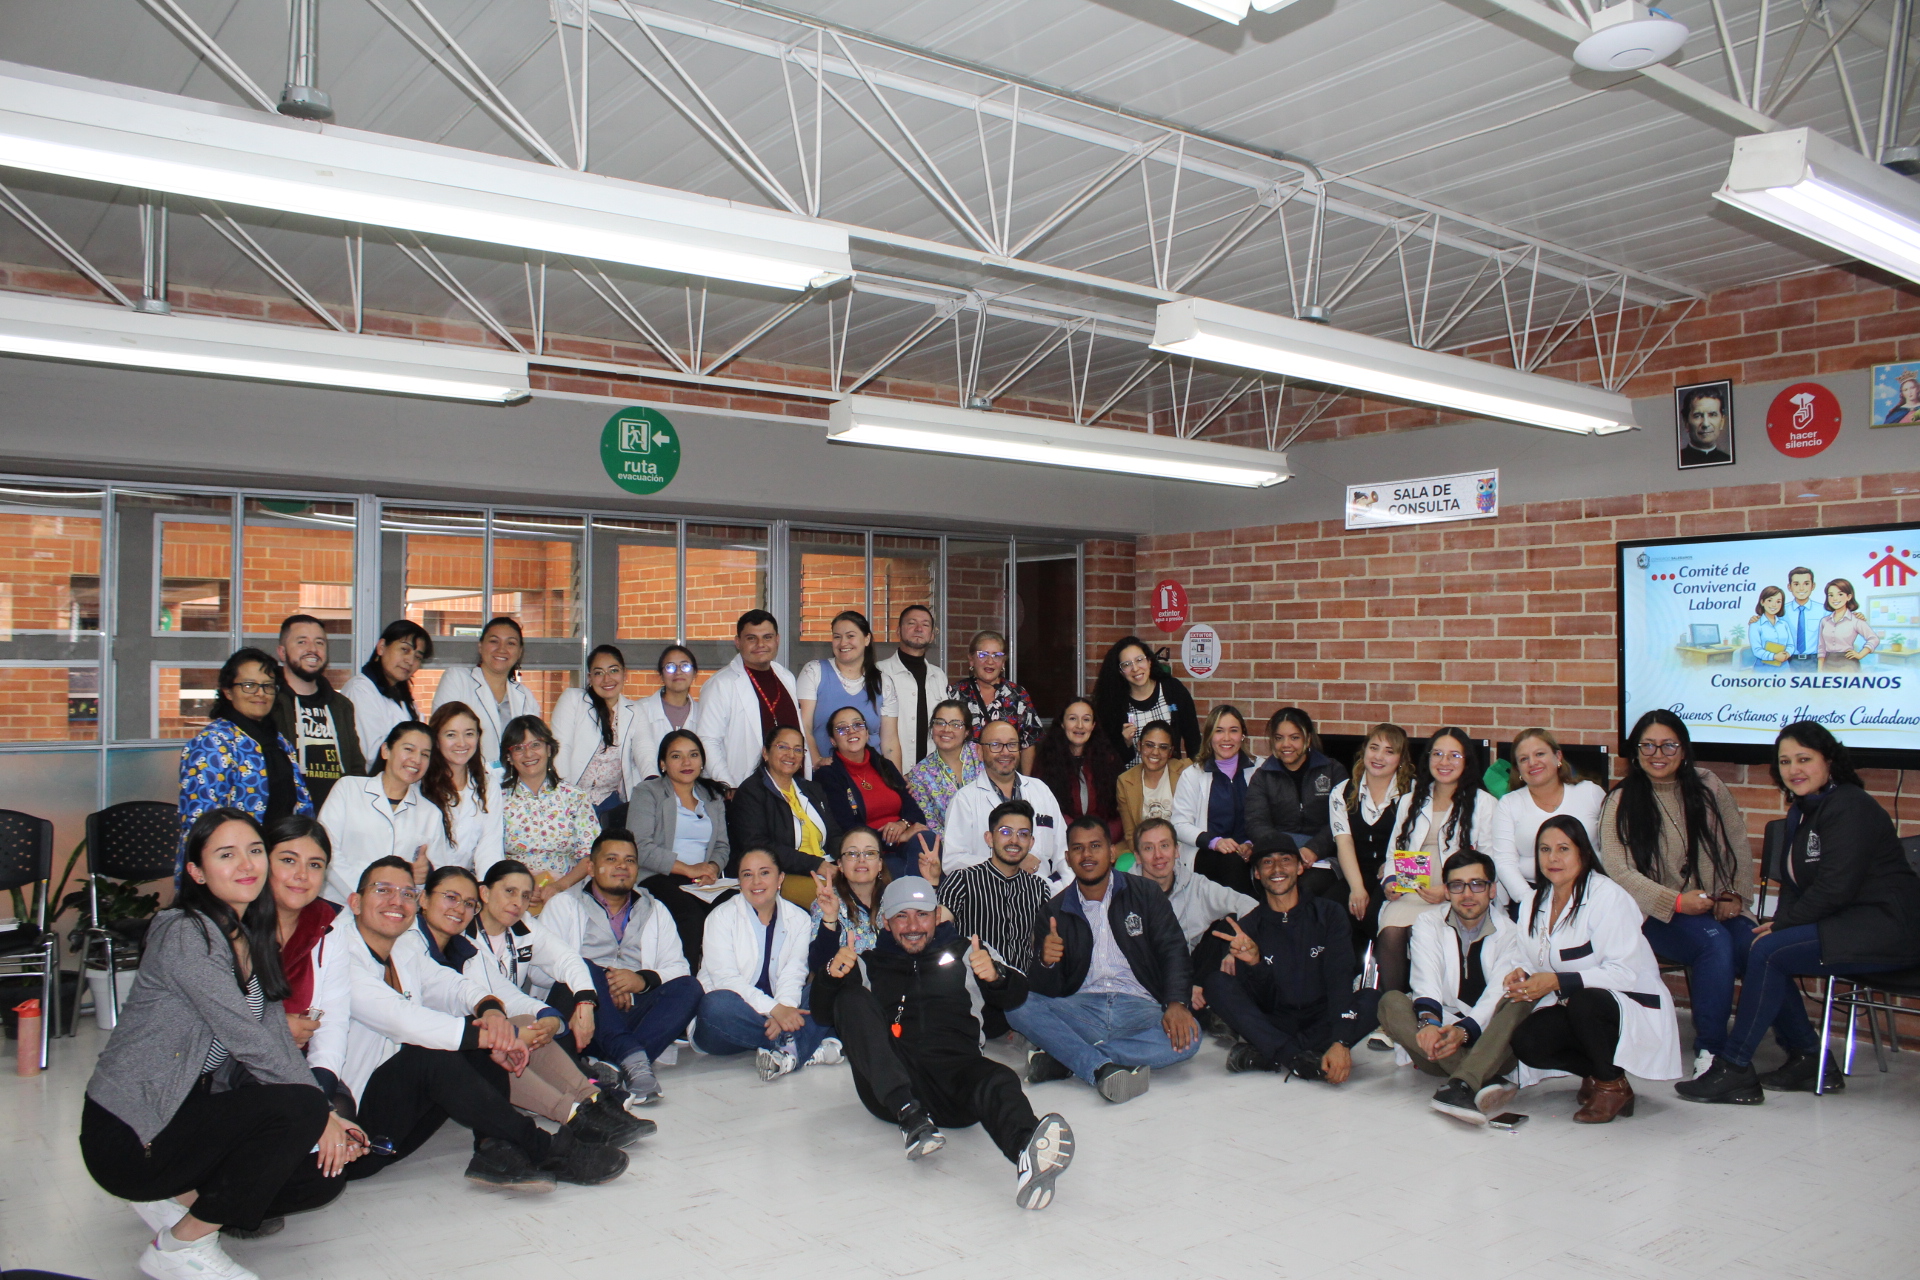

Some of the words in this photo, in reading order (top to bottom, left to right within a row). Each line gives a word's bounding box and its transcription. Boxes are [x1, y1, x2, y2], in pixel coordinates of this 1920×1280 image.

[1790, 431, 1818, 440] hacer
[1785, 438, 1823, 449] silencio
[624, 460, 657, 474] ruta
[617, 473, 664, 483] evacuación
[1393, 486, 1429, 501] SALA
[1433, 483, 1452, 497] DE
[1388, 498, 1461, 516] CONSULTA
[1678, 564, 1729, 578] Comité
[1732, 562, 1750, 576] de
[1673, 579, 1756, 594] Convivencia
[1688, 596, 1742, 611] Laboral
[1710, 674, 1786, 688] Consorcio
[1790, 676, 1902, 689] SALESIANOS
[1668, 702, 1714, 721] Buenos
[1717, 704, 1778, 722] Cristianos
[1780, 714, 1789, 728] y
[1793, 704, 1846, 724] Honestos
[306, 771, 340, 779] TRADEMAR
[1396, 864, 1426, 874] Trululu
